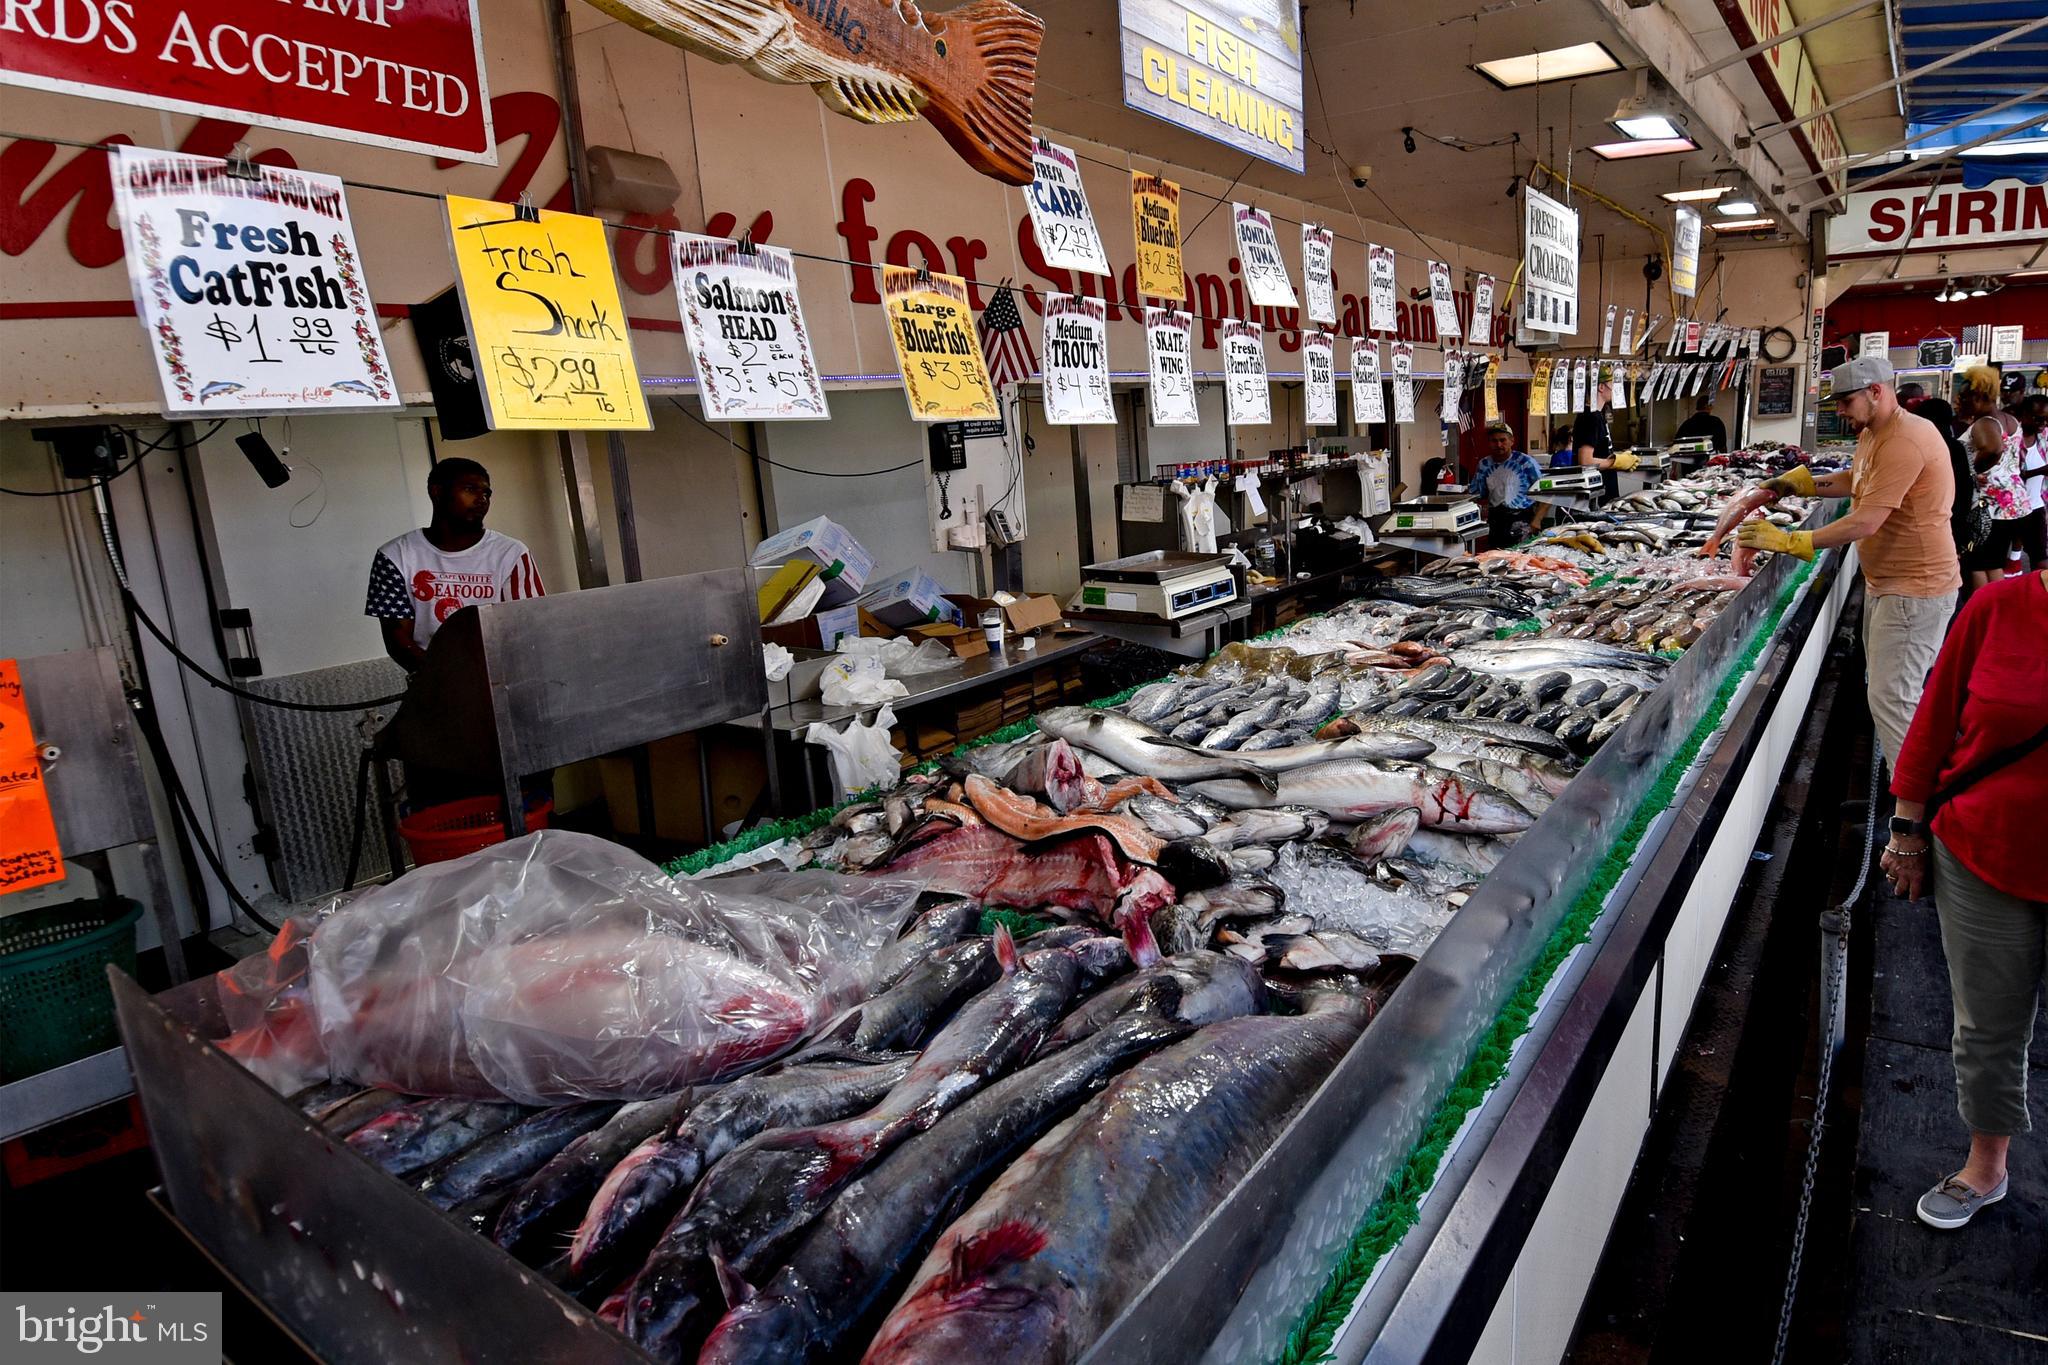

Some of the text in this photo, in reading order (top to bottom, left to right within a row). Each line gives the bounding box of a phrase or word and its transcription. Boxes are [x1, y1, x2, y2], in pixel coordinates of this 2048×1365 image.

[158, 10, 470, 118] ACCEPTED
[1186, 12, 1260, 88] FISH
[1142, 47, 1294, 155] CLEANING
[1034, 161, 1065, 183] FRESH
[1032, 180, 1084, 220] CARP
[1142, 196, 1170, 221] Medium
[176, 208, 322, 257] Fresh
[1139, 215, 1176, 249] BlueFish
[1530, 205, 1573, 253] FRESH BAY
[458, 217, 586, 278] Fresh
[1248, 246, 1276, 266] TUNA
[1530, 244, 1574, 288] CROAKERS
[169, 255, 348, 309] CatFish
[695, 271, 786, 315] Salmon
[496, 271, 622, 342] Shark
[901, 298, 956, 320] Large
[718, 314, 777, 342] HEAD
[901, 317, 971, 356] BlueFish
[1055, 318, 1093, 340] Medium
[1155, 330, 1184, 353] SKATE
[1051, 339, 1100, 370] TROUT
[1231, 341, 1258, 356] Fresh
[1308, 351, 1329, 369] White
[1160, 356, 1184, 375] WING
[1230, 356, 1263, 375] Parrot Fish
[1312, 369, 1329, 383] BASS
[458, 575, 492, 583] WHITE
